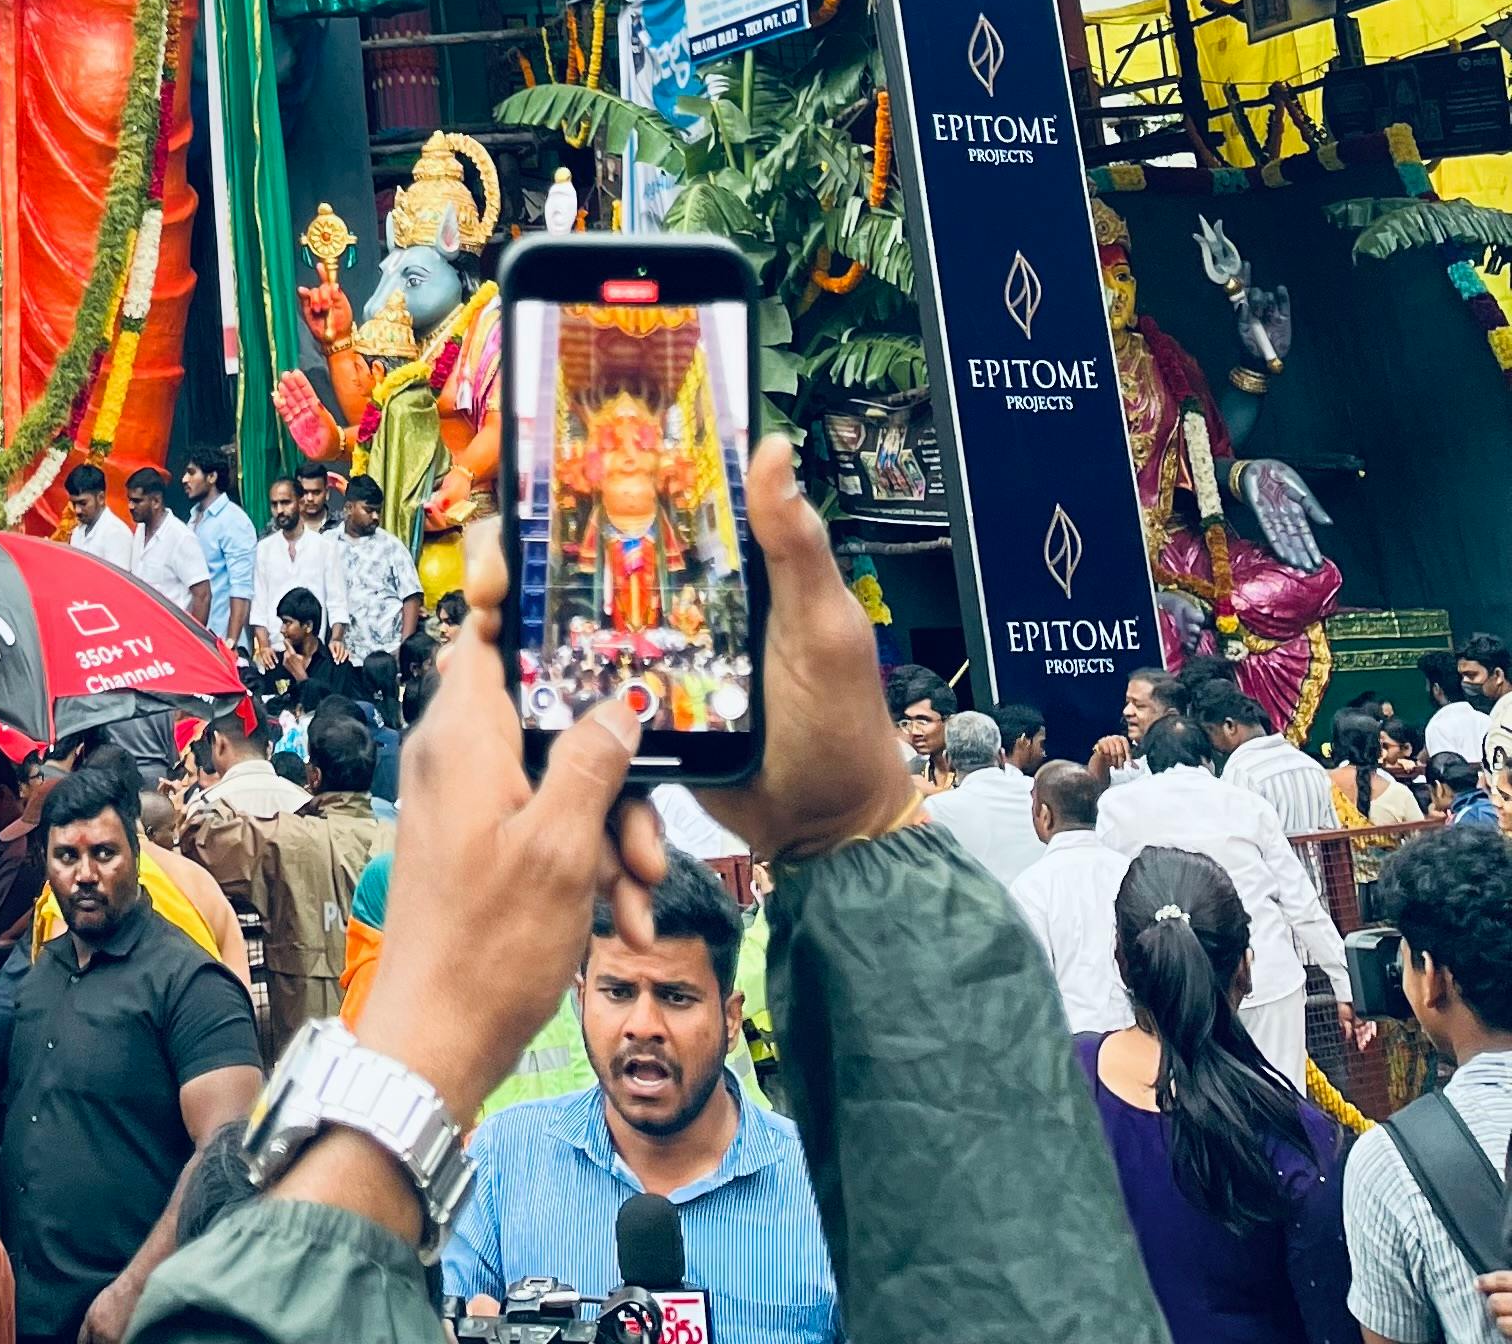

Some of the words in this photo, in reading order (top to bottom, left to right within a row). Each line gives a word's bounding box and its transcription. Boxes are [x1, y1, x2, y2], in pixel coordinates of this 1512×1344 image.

[932, 114, 1058, 144] EPITOME
[968, 150, 1034, 166] PROJECTS
[1007, 620, 1140, 651] EPITOME
[76, 648, 119, 670] 350+
[123, 636, 153, 658] TV
[1046, 659, 1114, 677] PROJECTS
[86, 660, 175, 695] Channels
